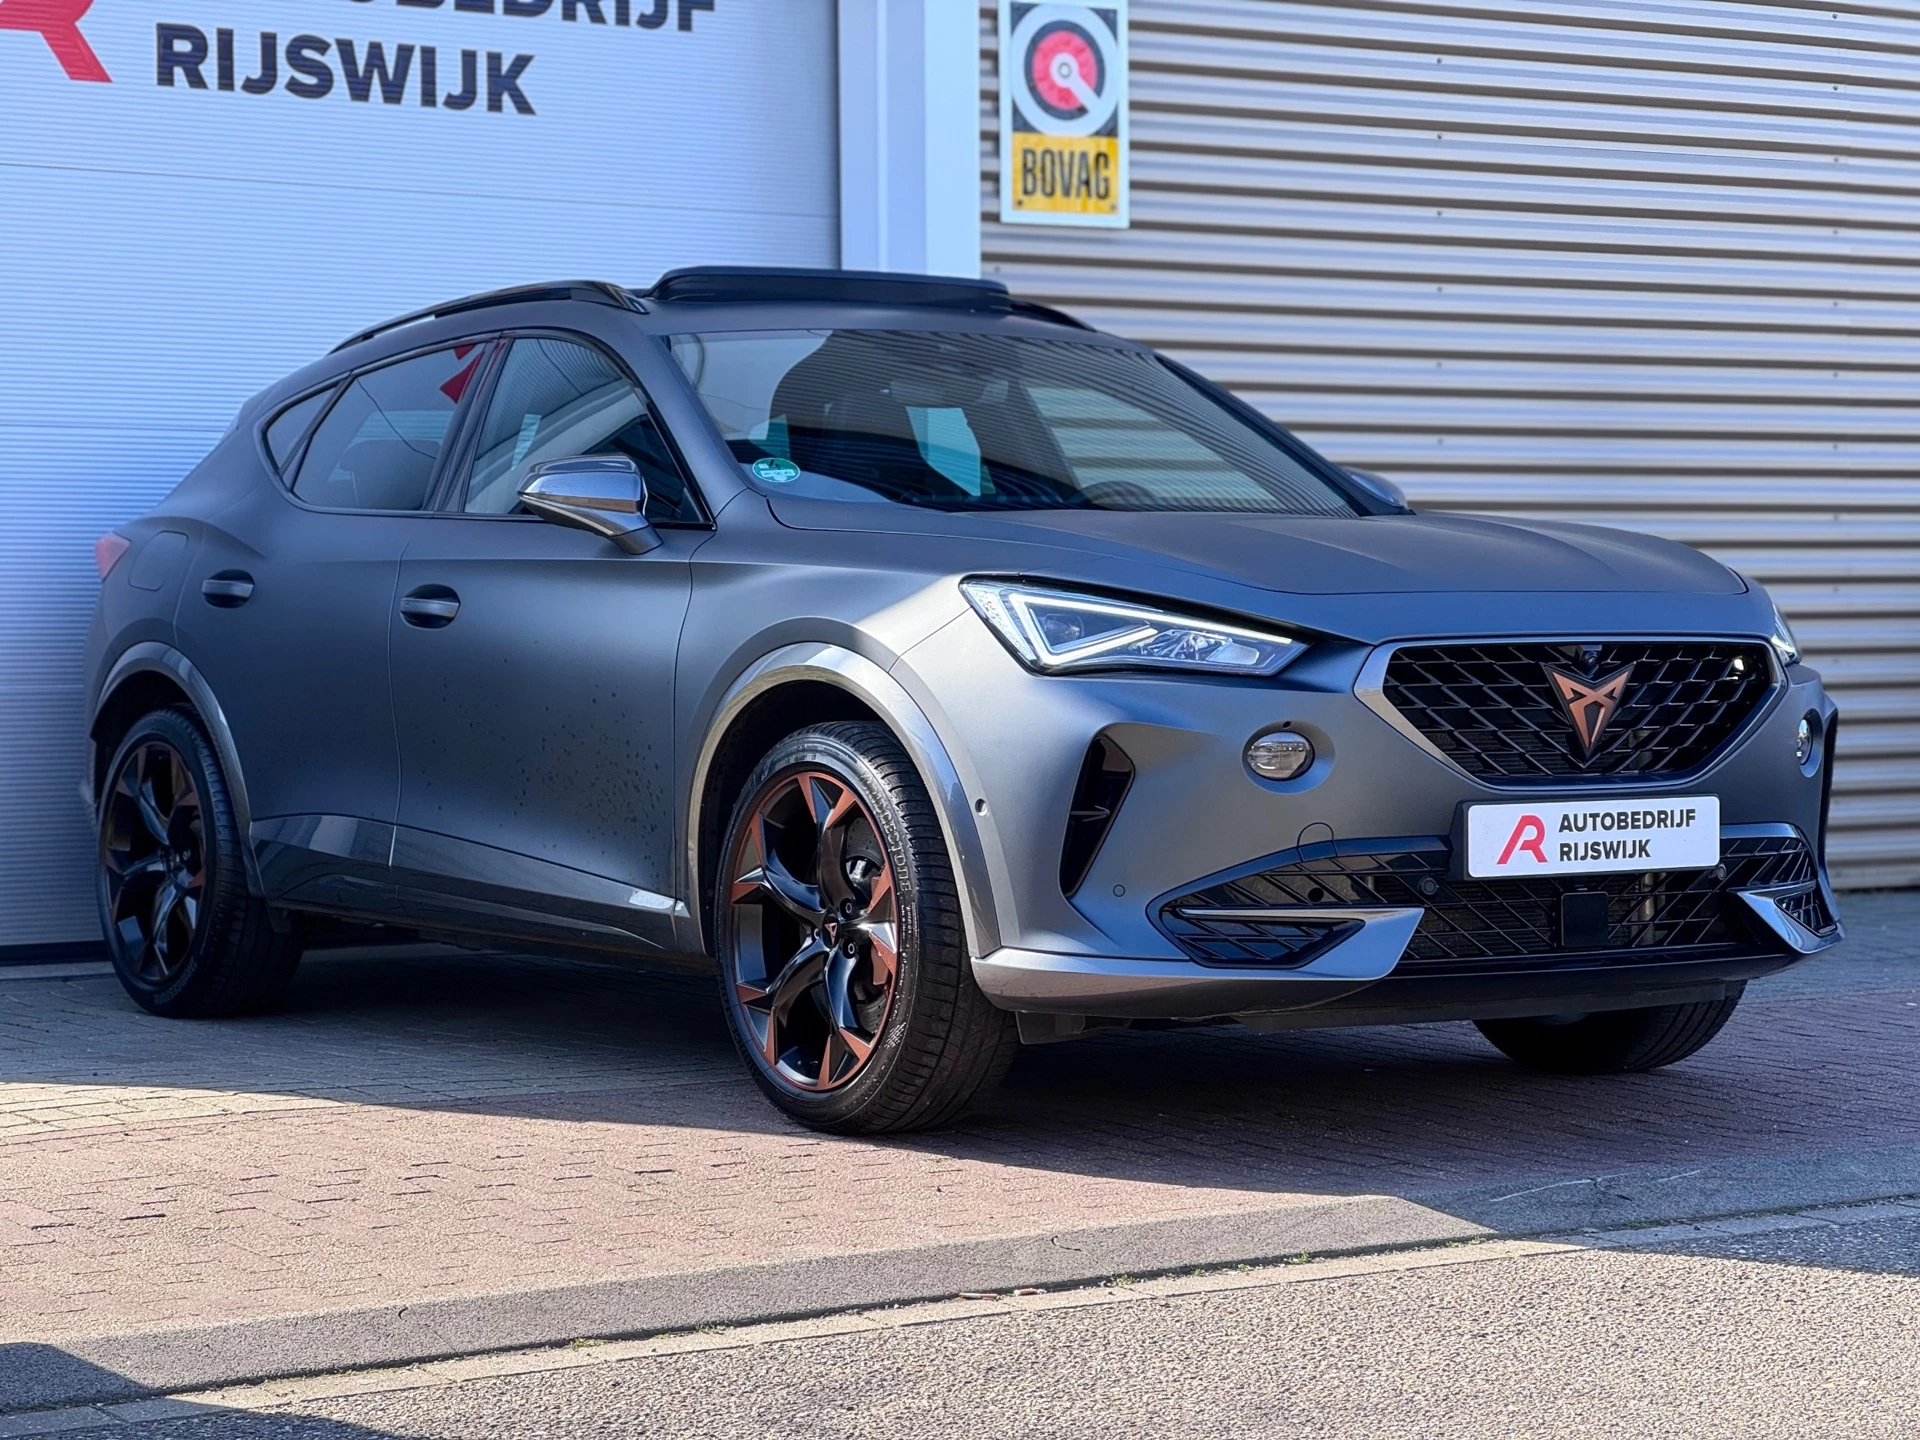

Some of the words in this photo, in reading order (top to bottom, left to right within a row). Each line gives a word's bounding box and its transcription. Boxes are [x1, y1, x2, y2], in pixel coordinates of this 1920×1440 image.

[155, 22, 537, 116] RIJSWIJK
[1022, 148, 1110, 200] BOVAG
[1559, 809, 1695, 832] AUTOBEDRIJF
[1560, 840, 1650, 861] RIJSWIJK
